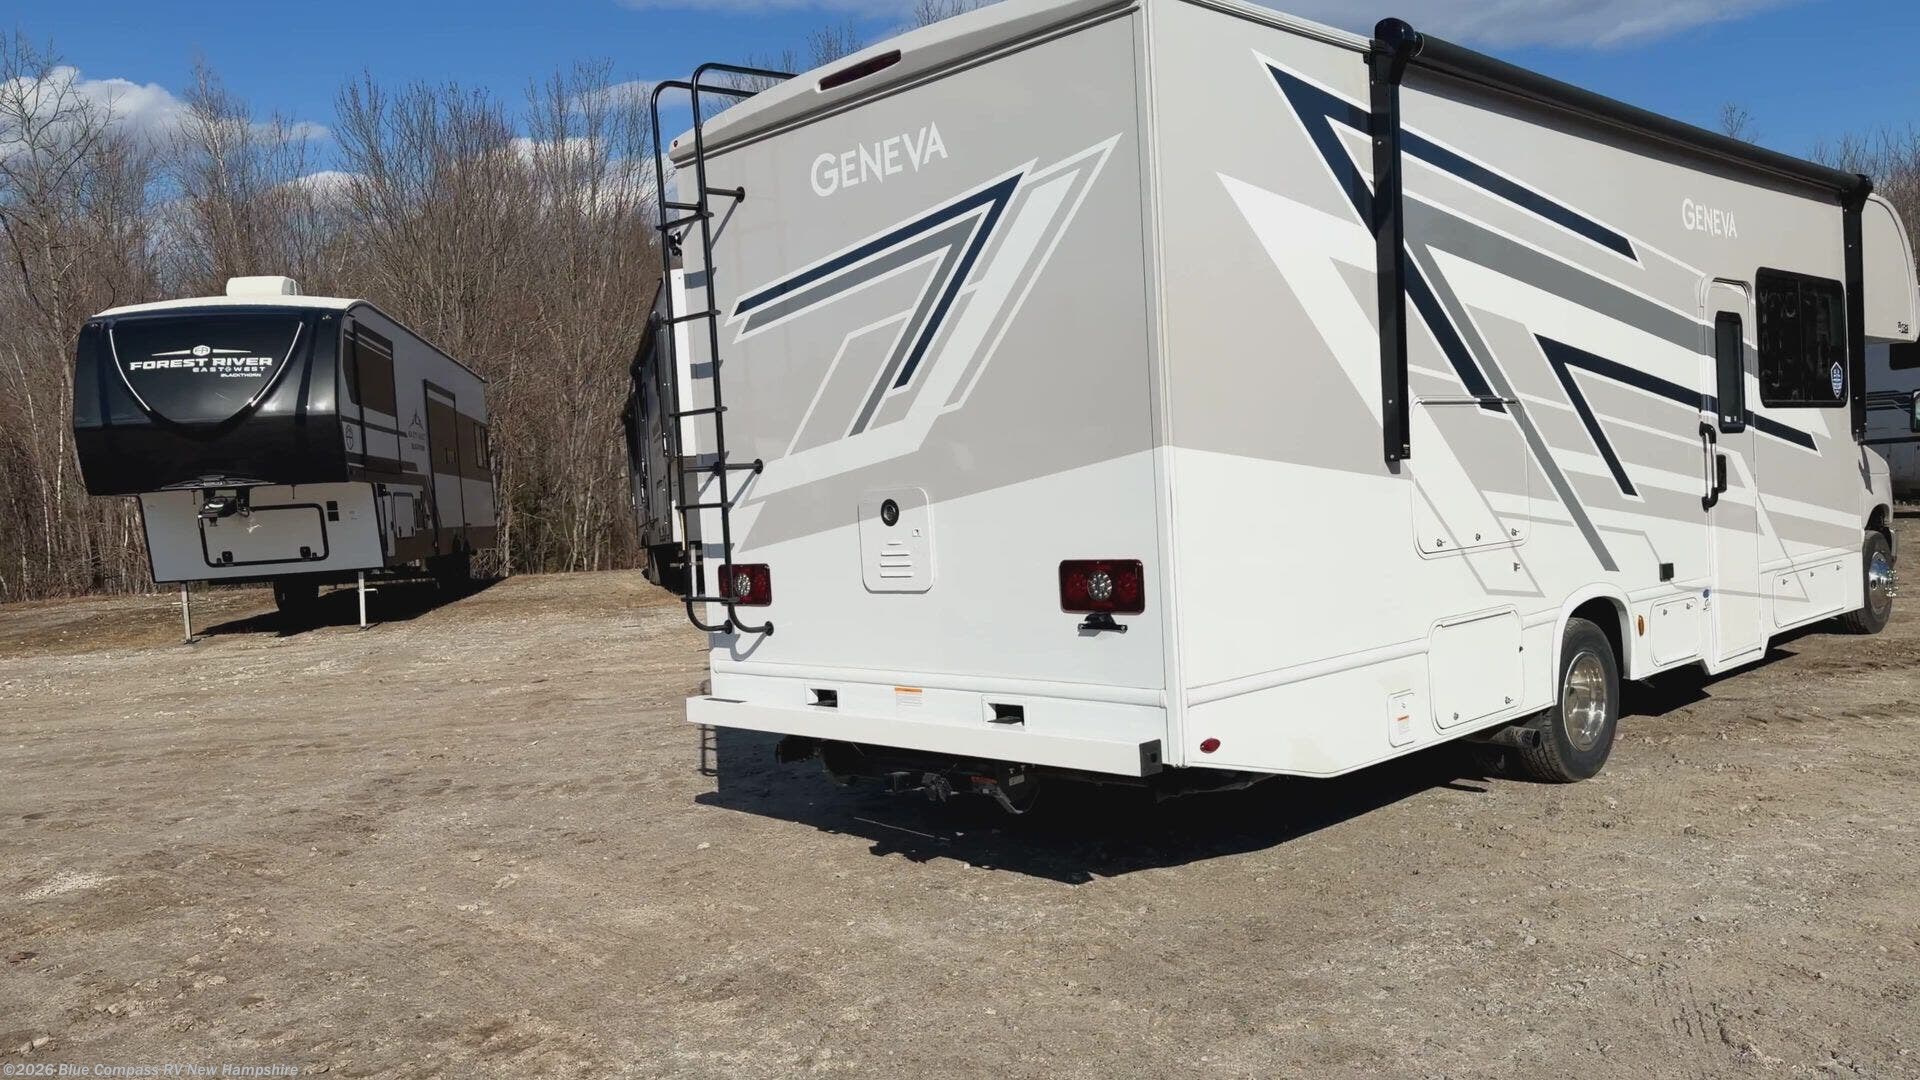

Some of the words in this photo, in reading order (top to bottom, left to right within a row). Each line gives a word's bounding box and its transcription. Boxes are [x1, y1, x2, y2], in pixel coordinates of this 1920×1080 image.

[810, 120, 949, 197] GENEVA
[1682, 198, 1737, 239] GENEVA
[130, 358, 208, 371] FOREST
[212, 357, 273, 366] RIVER
